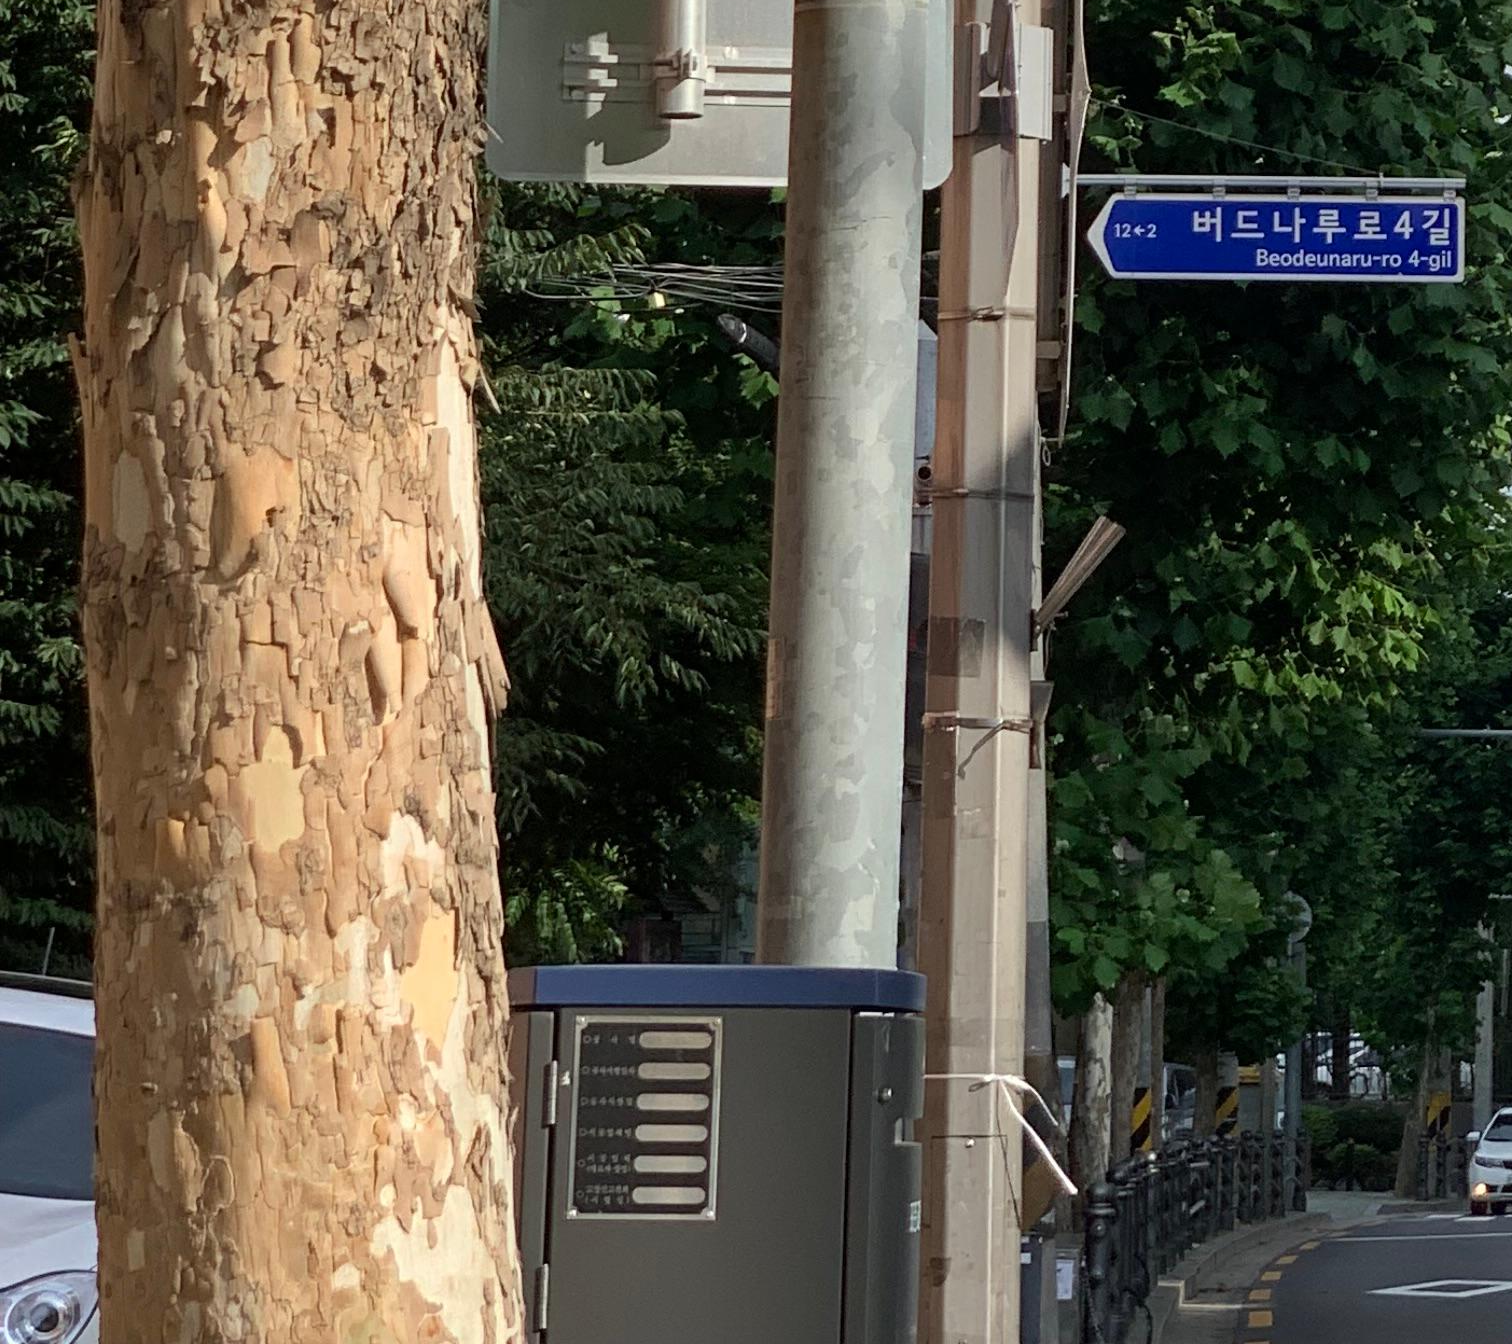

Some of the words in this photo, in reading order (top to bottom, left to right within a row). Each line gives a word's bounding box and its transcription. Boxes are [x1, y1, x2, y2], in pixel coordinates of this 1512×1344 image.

[1192, 207, 1451, 246] 버드나루로4길
[1256, 248, 1401, 268] Beodeunaru-ro
[1408, 249, 1452, 271] 4-gil
